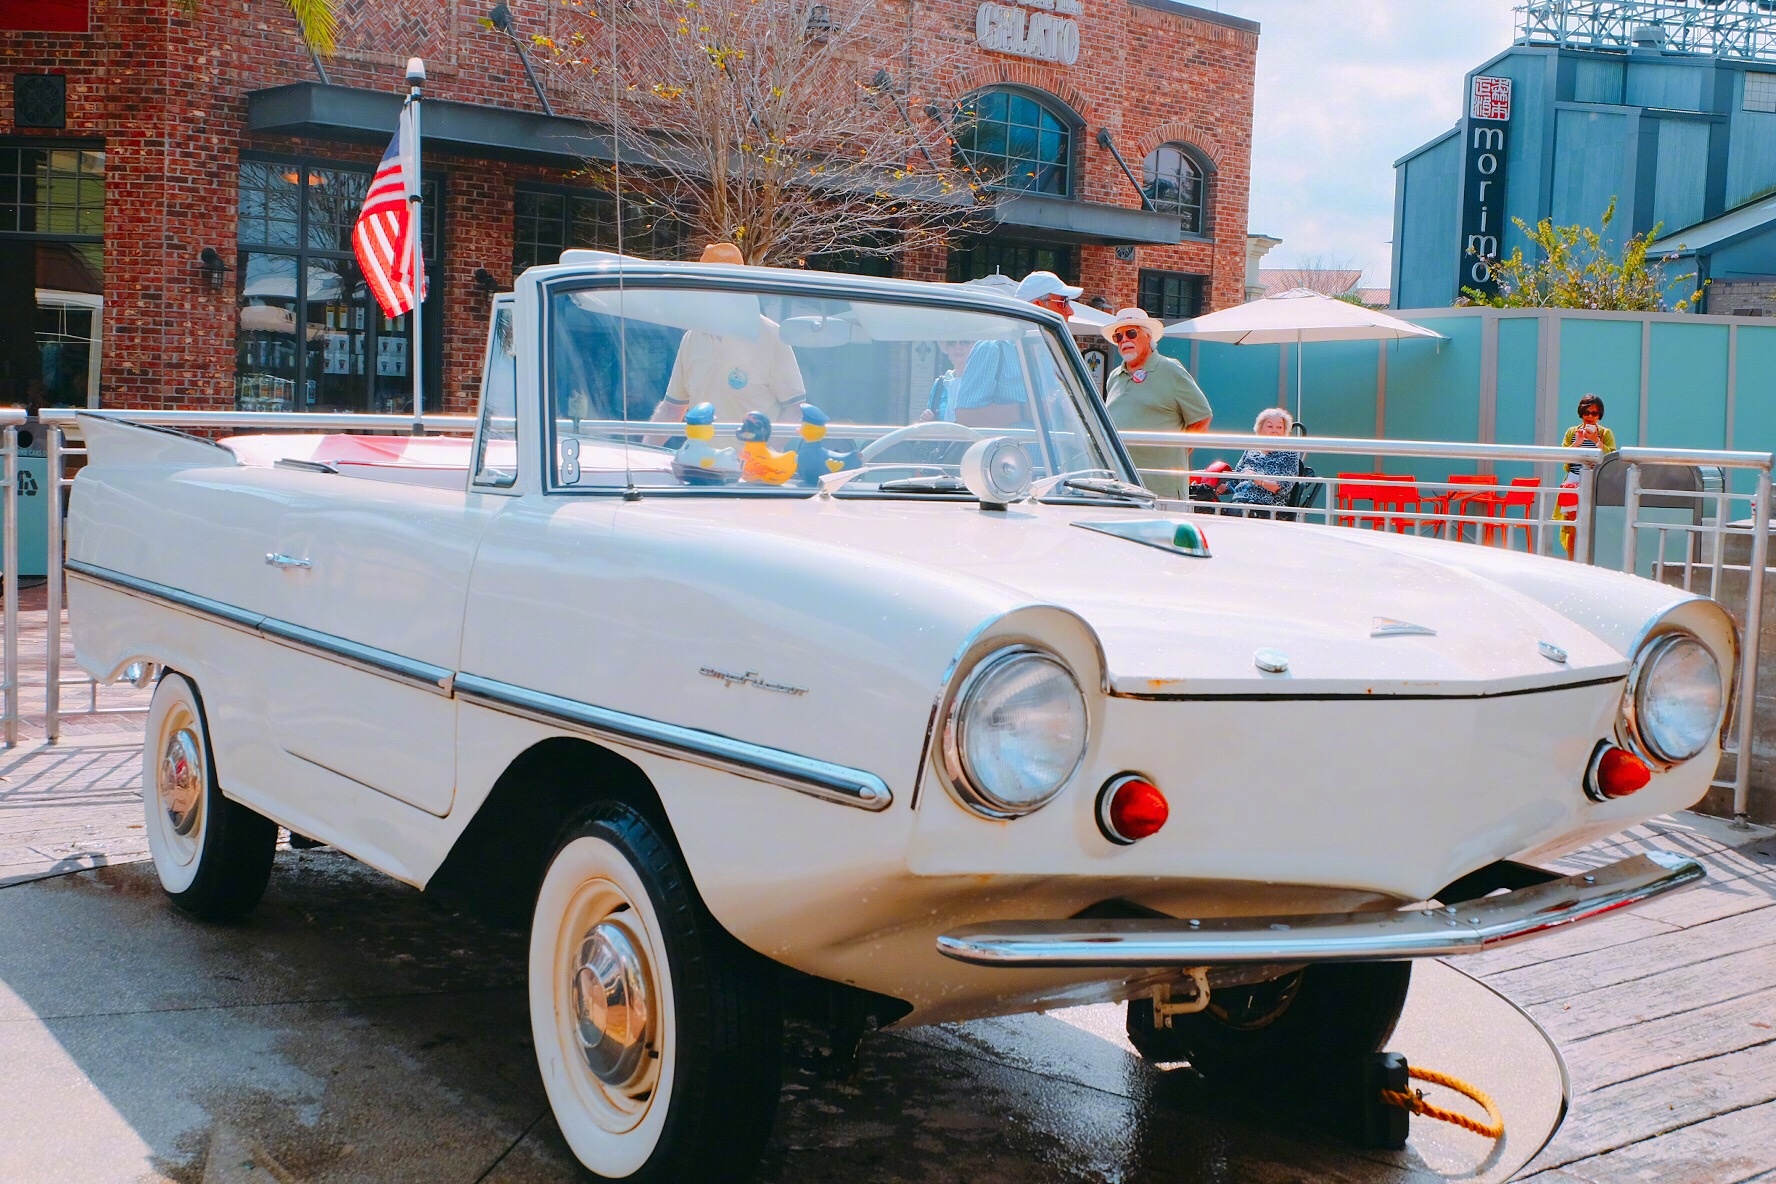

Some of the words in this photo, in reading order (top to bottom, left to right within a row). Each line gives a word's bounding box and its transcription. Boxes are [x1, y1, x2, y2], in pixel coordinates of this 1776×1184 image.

[976, 2, 1080, 65] GELATO
[1467, 127, 1504, 284] morimo
[561, 438, 580, 485] 8
